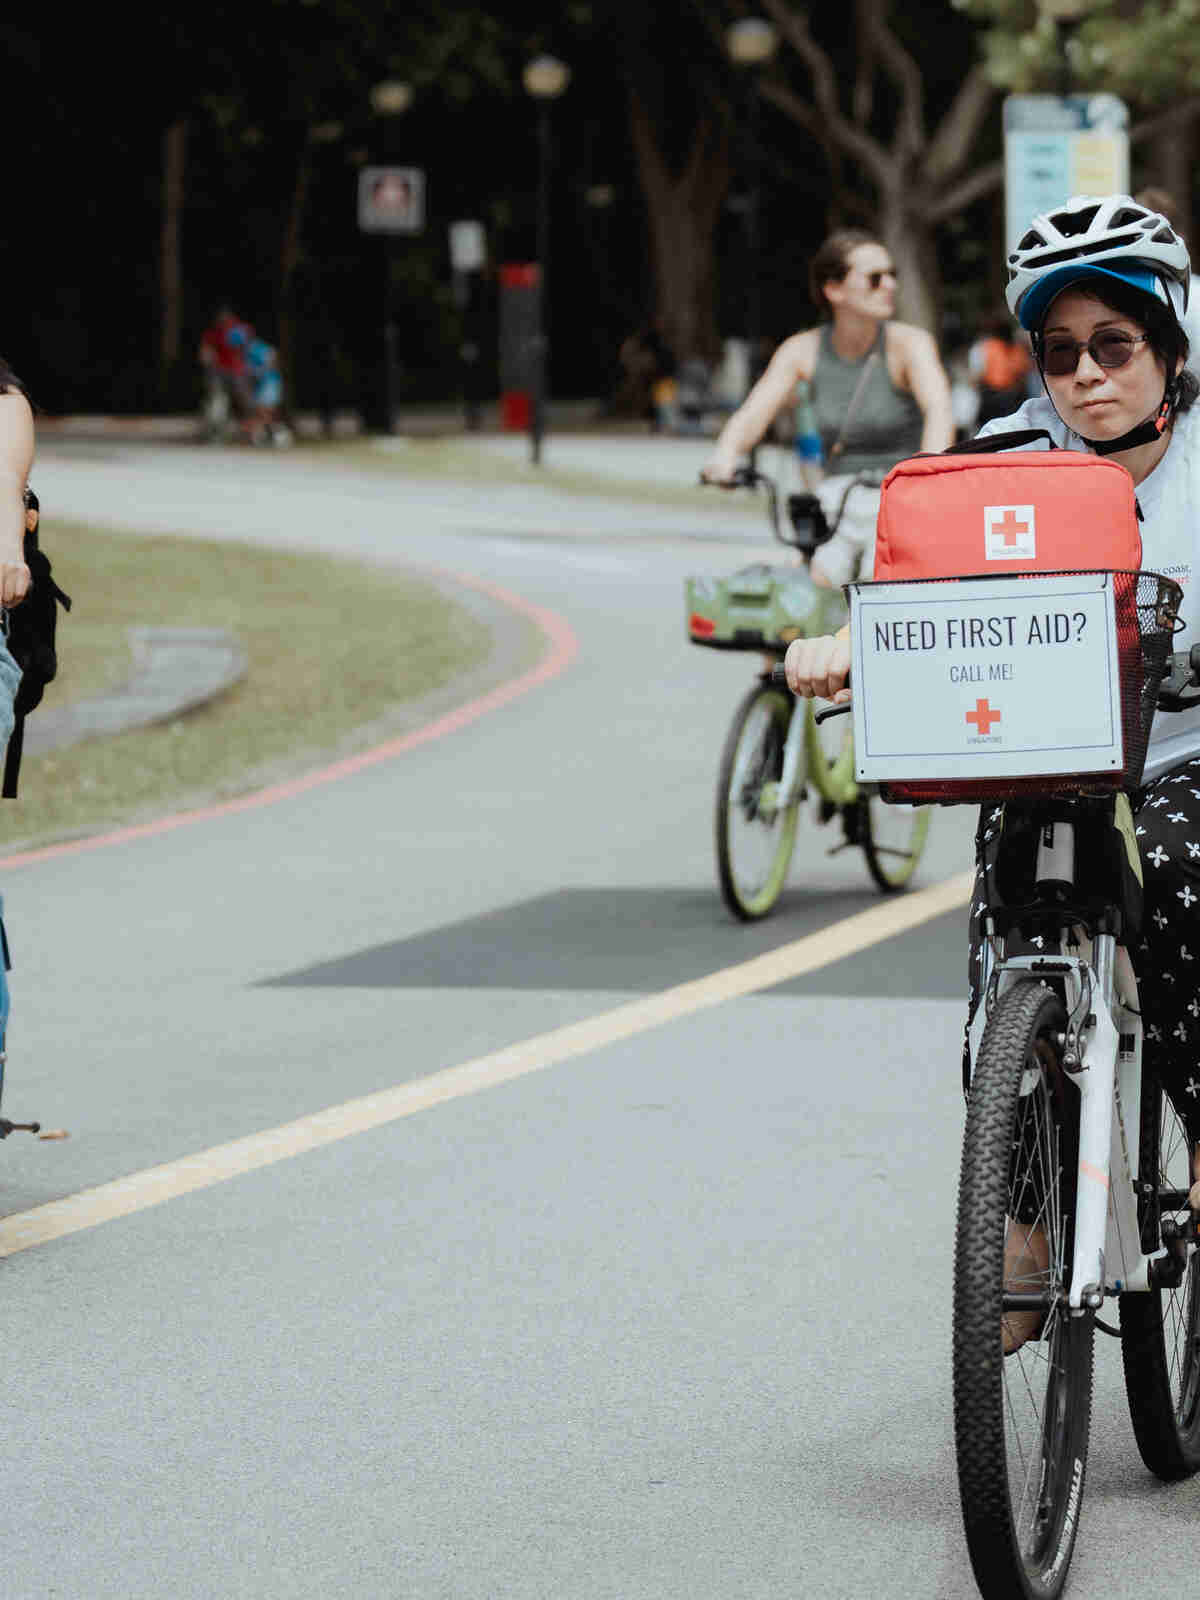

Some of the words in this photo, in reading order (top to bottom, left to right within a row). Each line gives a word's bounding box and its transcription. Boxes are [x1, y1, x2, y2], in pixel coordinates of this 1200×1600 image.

[875, 620, 936, 652] NEED
[946, 616, 1017, 649] FIRST
[1027, 612, 1087, 645] AID?
[950, 664, 984, 683] CALL
[989, 663, 1014, 681] ME!
